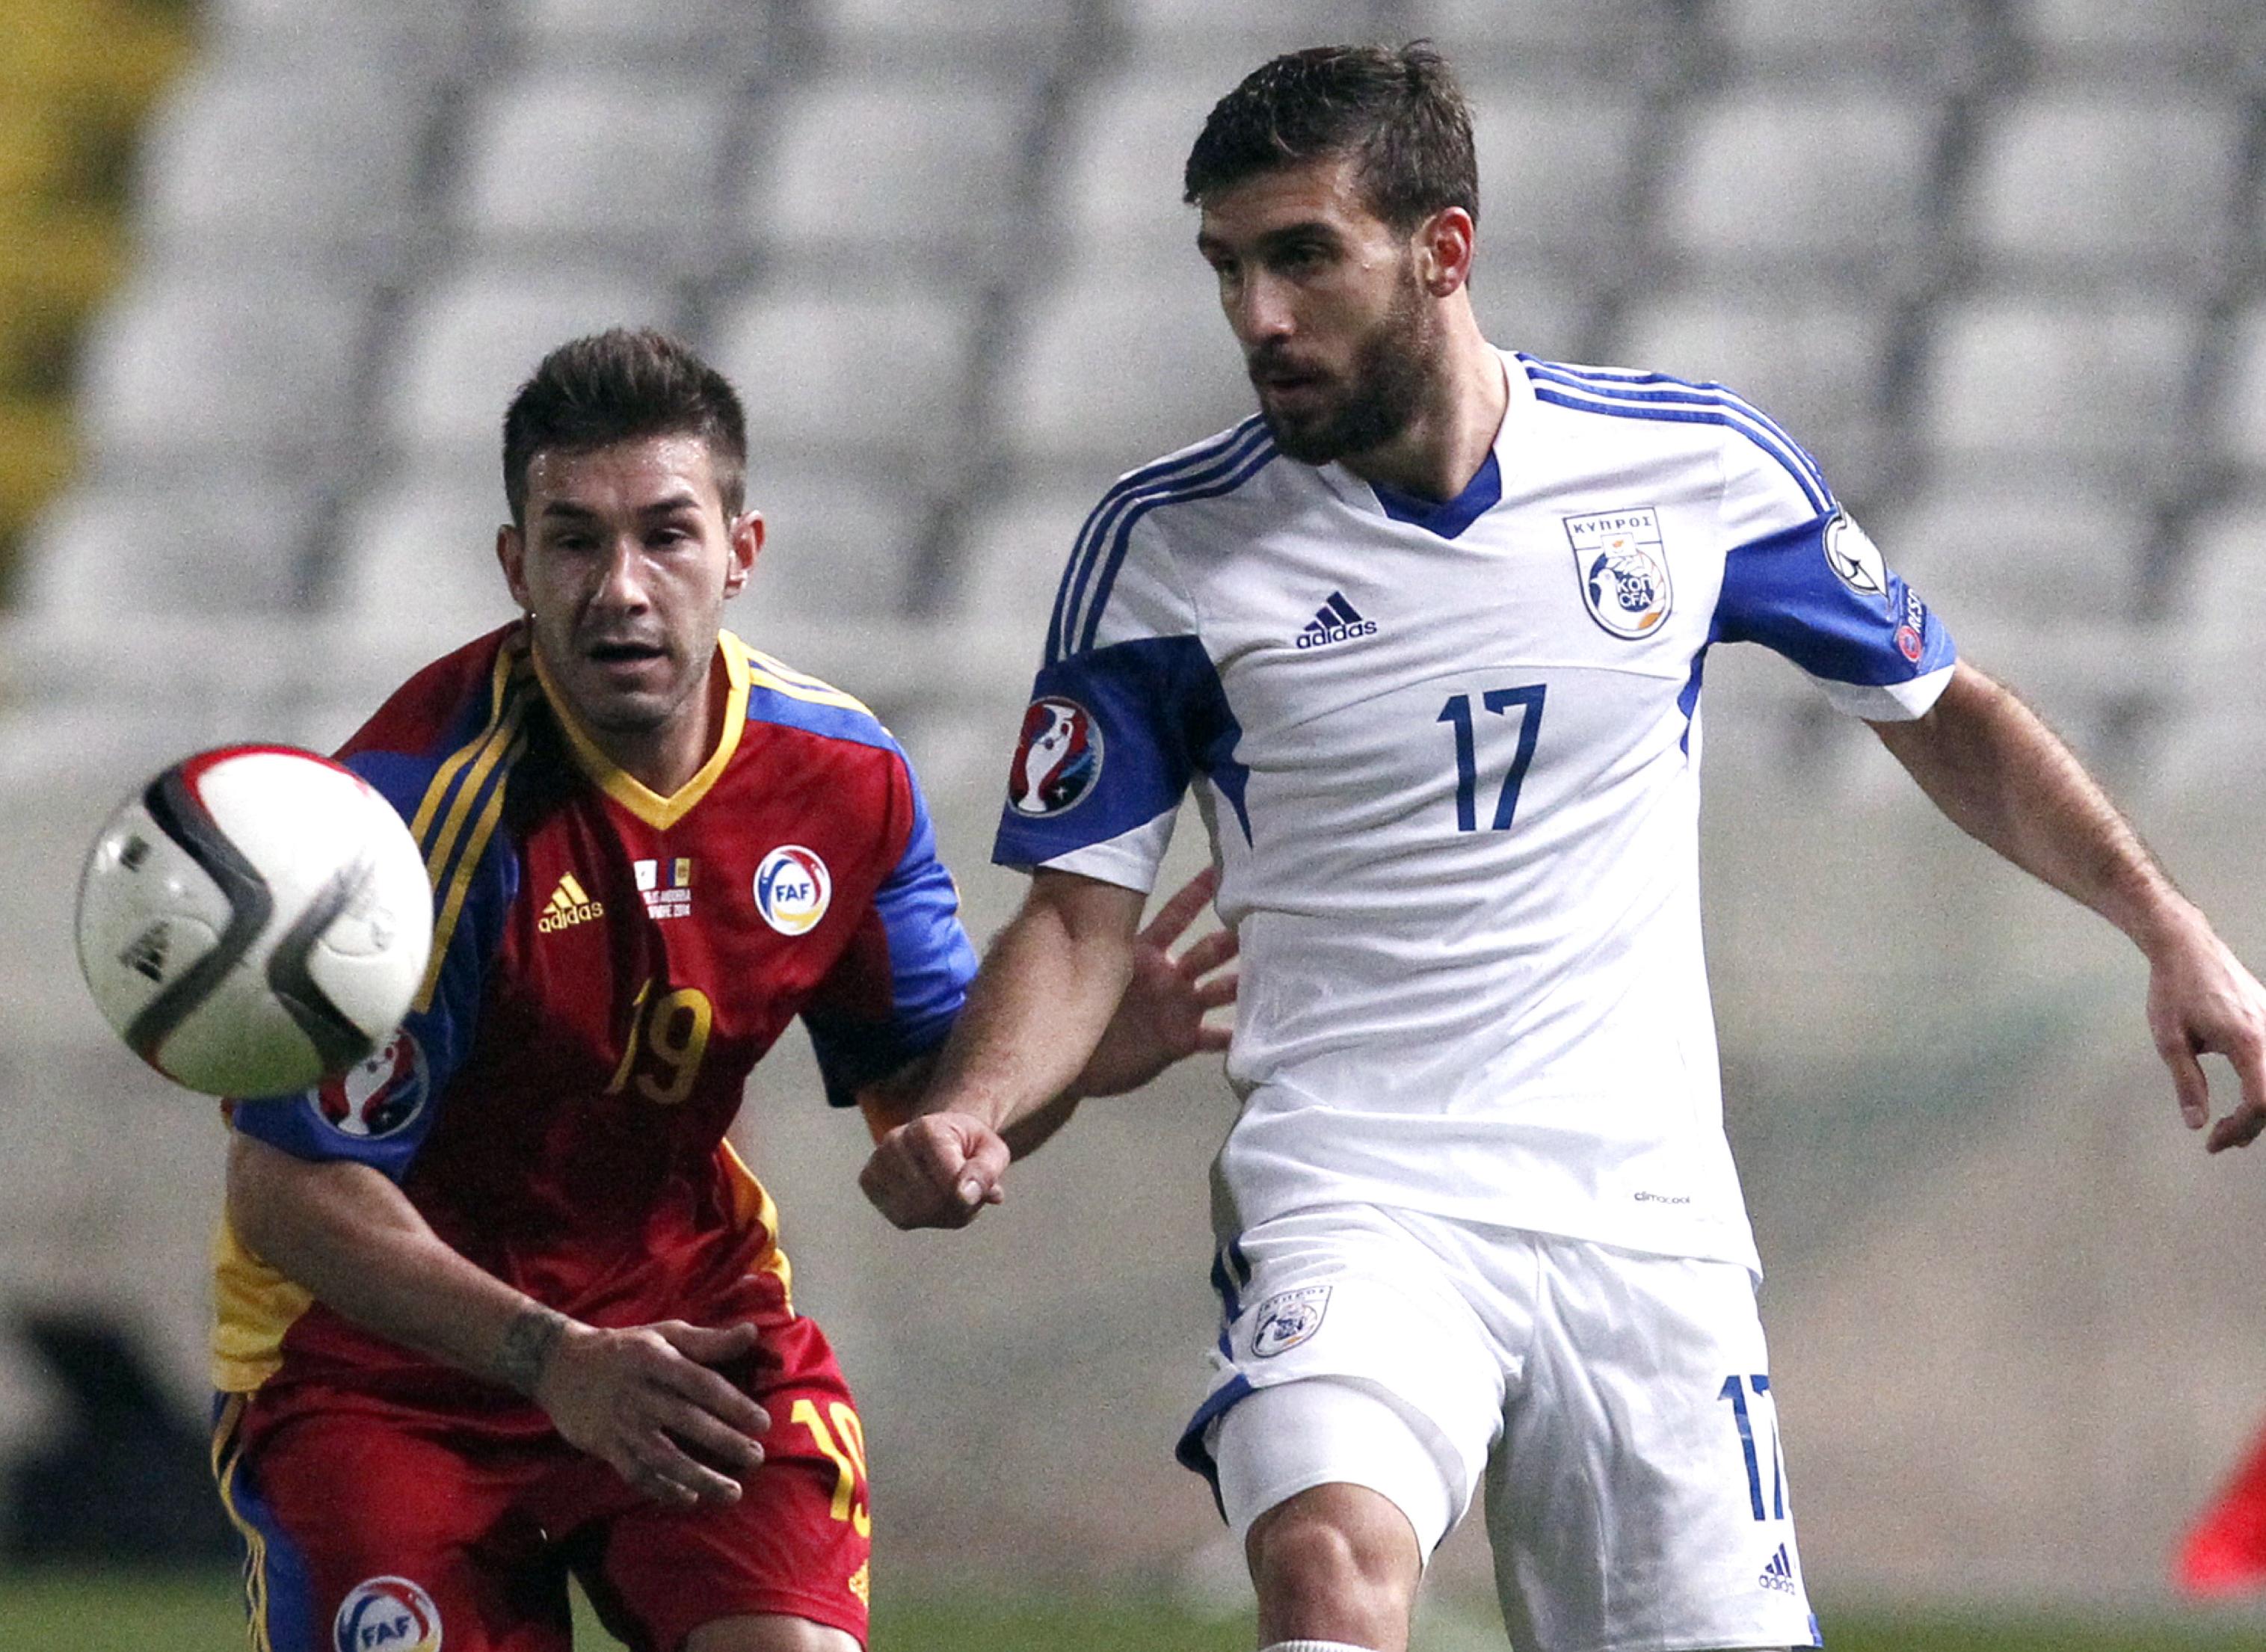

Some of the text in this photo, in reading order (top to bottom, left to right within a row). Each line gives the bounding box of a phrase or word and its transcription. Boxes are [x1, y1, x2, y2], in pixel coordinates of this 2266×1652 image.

[1619, 593, 1651, 607] CFA
[1296, 621, 1377, 649] adidas
[1436, 683, 1547, 831] 17
[775, 883, 810, 903] FAF
[538, 901, 603, 933] adidas
[603, 978, 712, 1104] 19
[361, 1615, 410, 1649] FAF
